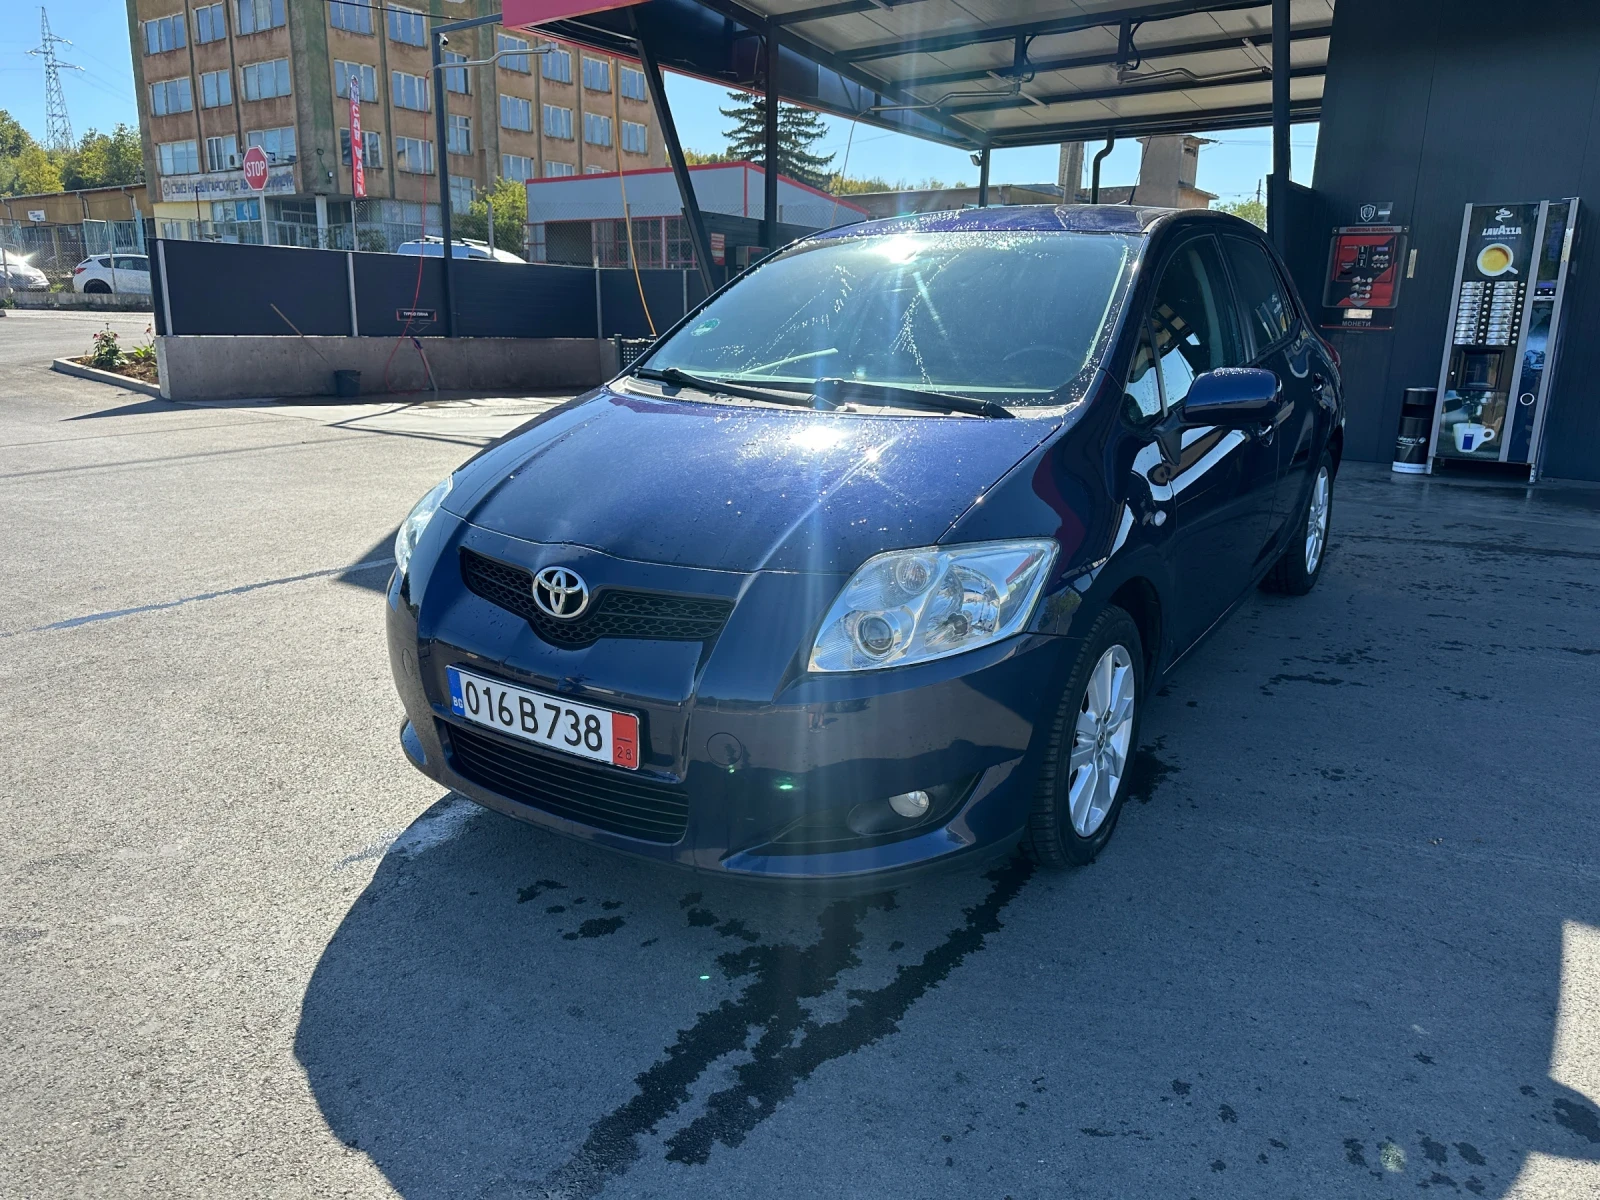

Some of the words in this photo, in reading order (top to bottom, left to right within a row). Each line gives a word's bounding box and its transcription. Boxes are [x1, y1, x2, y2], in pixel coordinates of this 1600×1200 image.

[352, 104, 361, 141] CAR
[246, 160, 265, 178] STOP
[1481, 225, 1522, 236] LAVAZZA
[452, 696, 464, 709] BG
[465, 680, 603, 752] 016B738
[617, 746, 632, 761] 28
